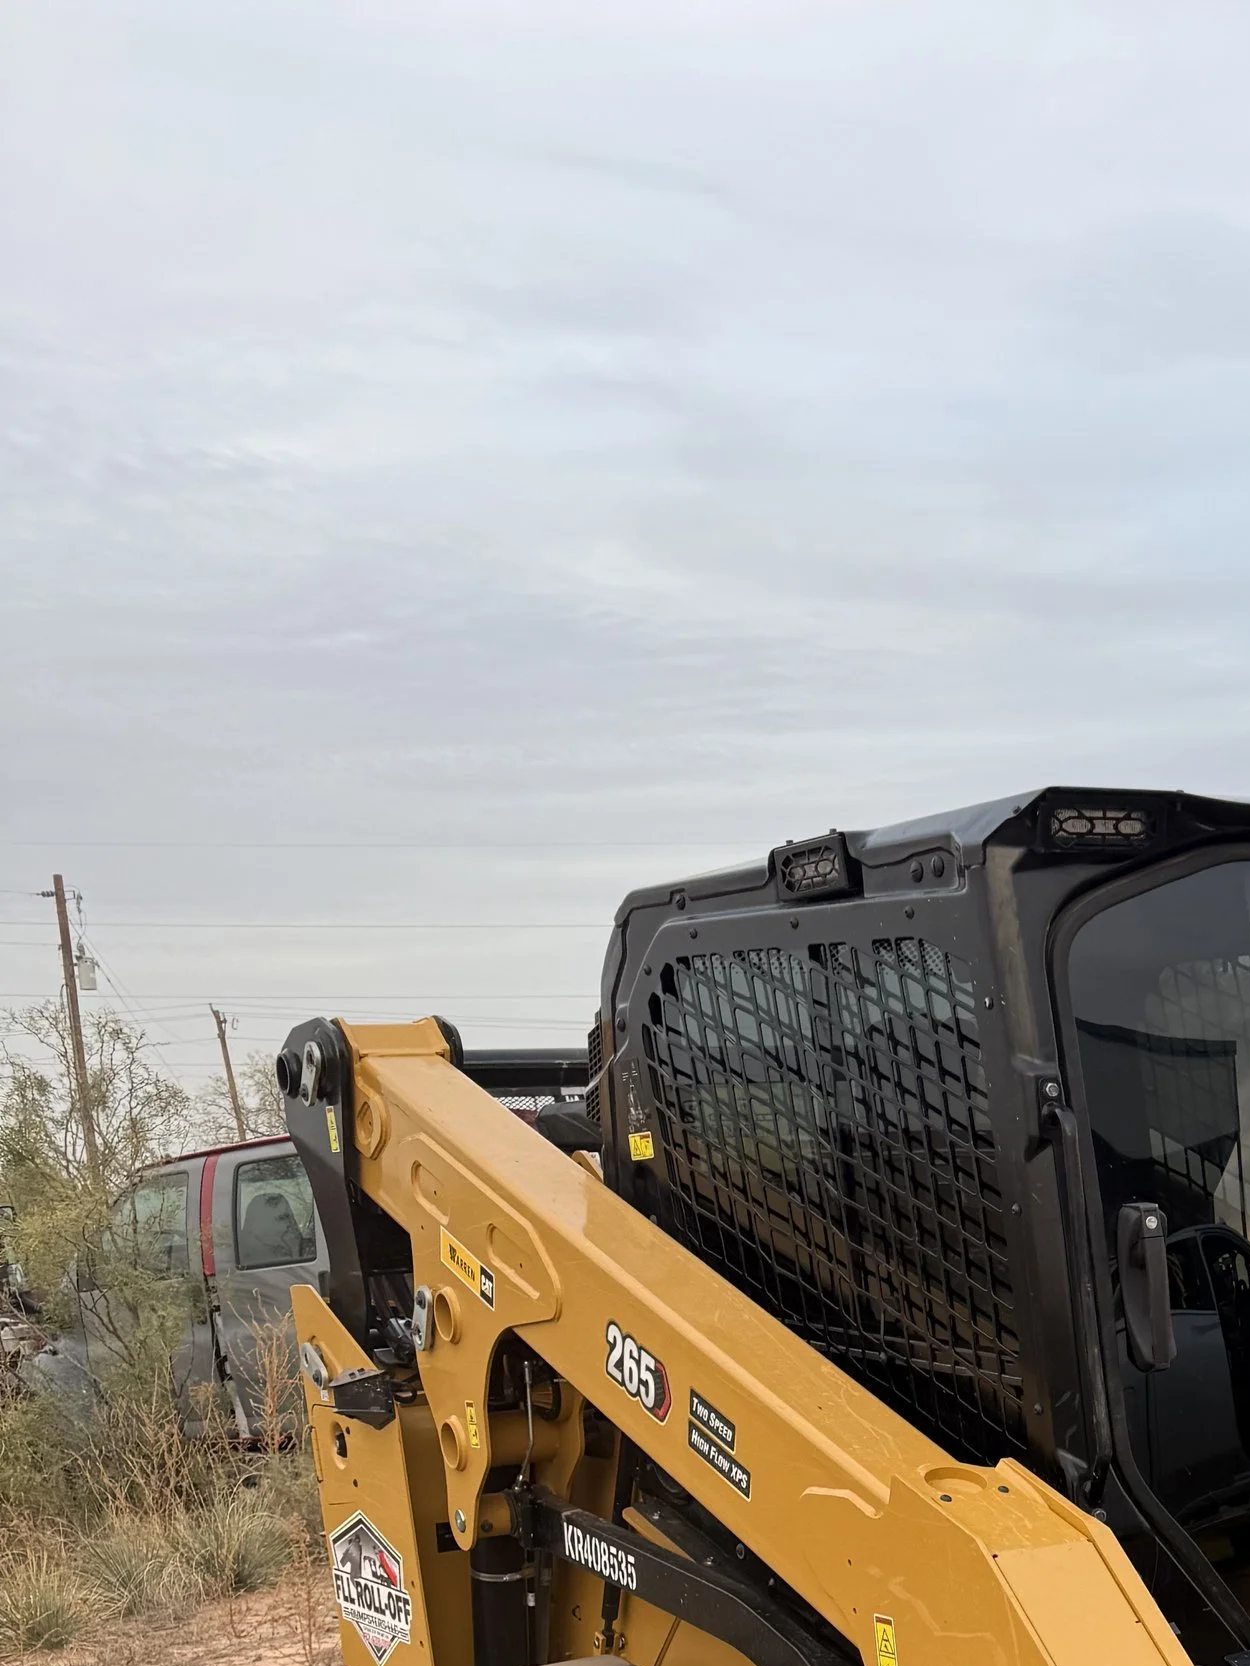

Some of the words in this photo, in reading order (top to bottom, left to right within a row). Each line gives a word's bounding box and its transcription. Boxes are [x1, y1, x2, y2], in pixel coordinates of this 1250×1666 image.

[448, 1243, 475, 1282] WARREN
[481, 1274, 493, 1299] CAT
[606, 1323, 657, 1409] 265
[692, 1396, 708, 1421] TWO
[709, 1412, 733, 1442] SPEED
[691, 1429, 709, 1455] HIGH
[710, 1445, 729, 1473] FLOW
[731, 1464, 748, 1489] XPS
[563, 1521, 637, 1590] KR408535
[355, 1580, 411, 1626] ROLL-OFF
